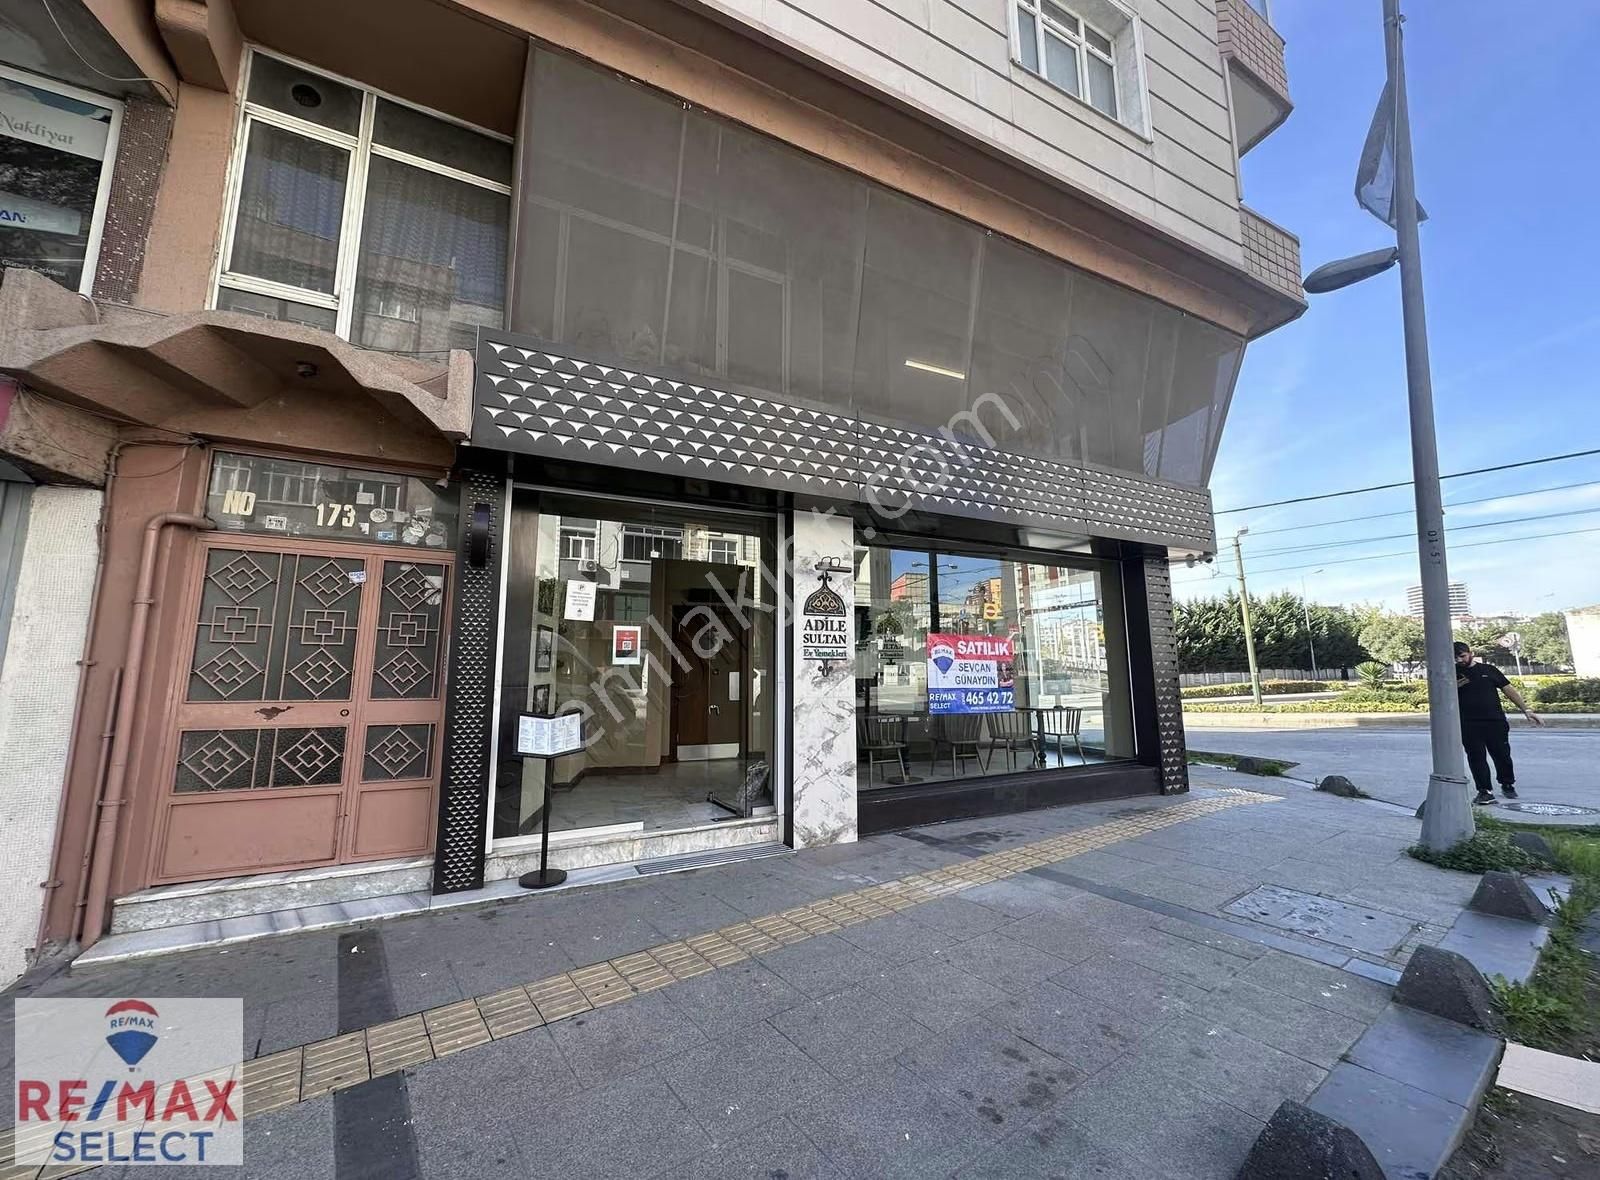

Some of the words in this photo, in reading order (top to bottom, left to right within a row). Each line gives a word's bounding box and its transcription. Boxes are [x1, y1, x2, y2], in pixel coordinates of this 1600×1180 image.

[222, 489, 256, 516] NO
[316, 503, 356, 527] 173
[803, 617, 846, 632] ADİLE
[803, 633, 847, 644] SULTAN
[803, 648, 813, 657] Ev
[814, 648, 847, 657] Yemekleri
[957, 640, 1010, 656] SATILIK
[954, 674, 996, 686] GÜNAYDIN
[929, 692, 956, 701] RE/MAX
[966, 691, 984, 705] 465
[986, 691, 999, 704] 42
[1001, 691, 1013, 704] 72
[930, 702, 951, 710] SELECT
